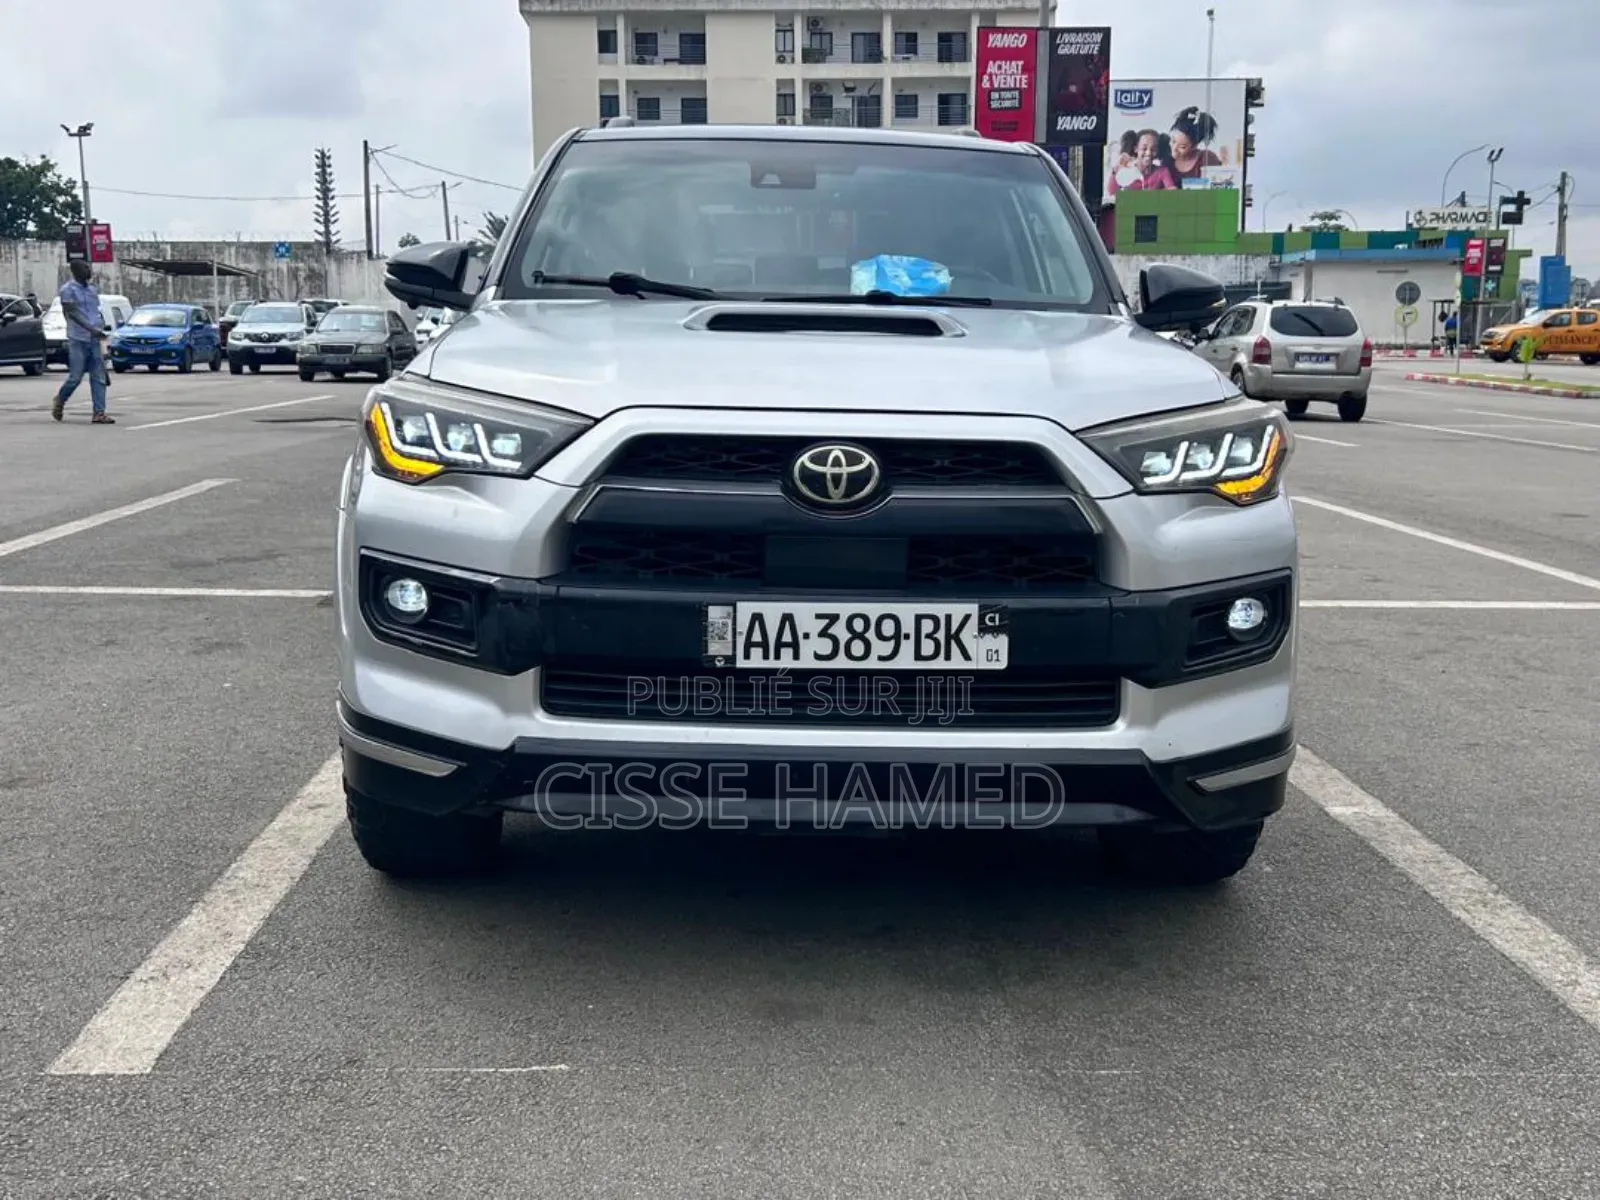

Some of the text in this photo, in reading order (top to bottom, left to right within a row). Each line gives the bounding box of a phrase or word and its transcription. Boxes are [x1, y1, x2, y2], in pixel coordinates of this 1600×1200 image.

[987, 33, 1028, 49] YANGO
[1056, 32, 1104, 44] LIVRAISON
[1057, 43, 1101, 55] GRATUITE
[986, 60, 1024, 75] ACHAT
[981, 74, 1029, 89] & VENTE
[1056, 115, 1098, 131] YANGO
[984, 612, 1000, 626] CI
[985, 648, 1001, 663] 01
